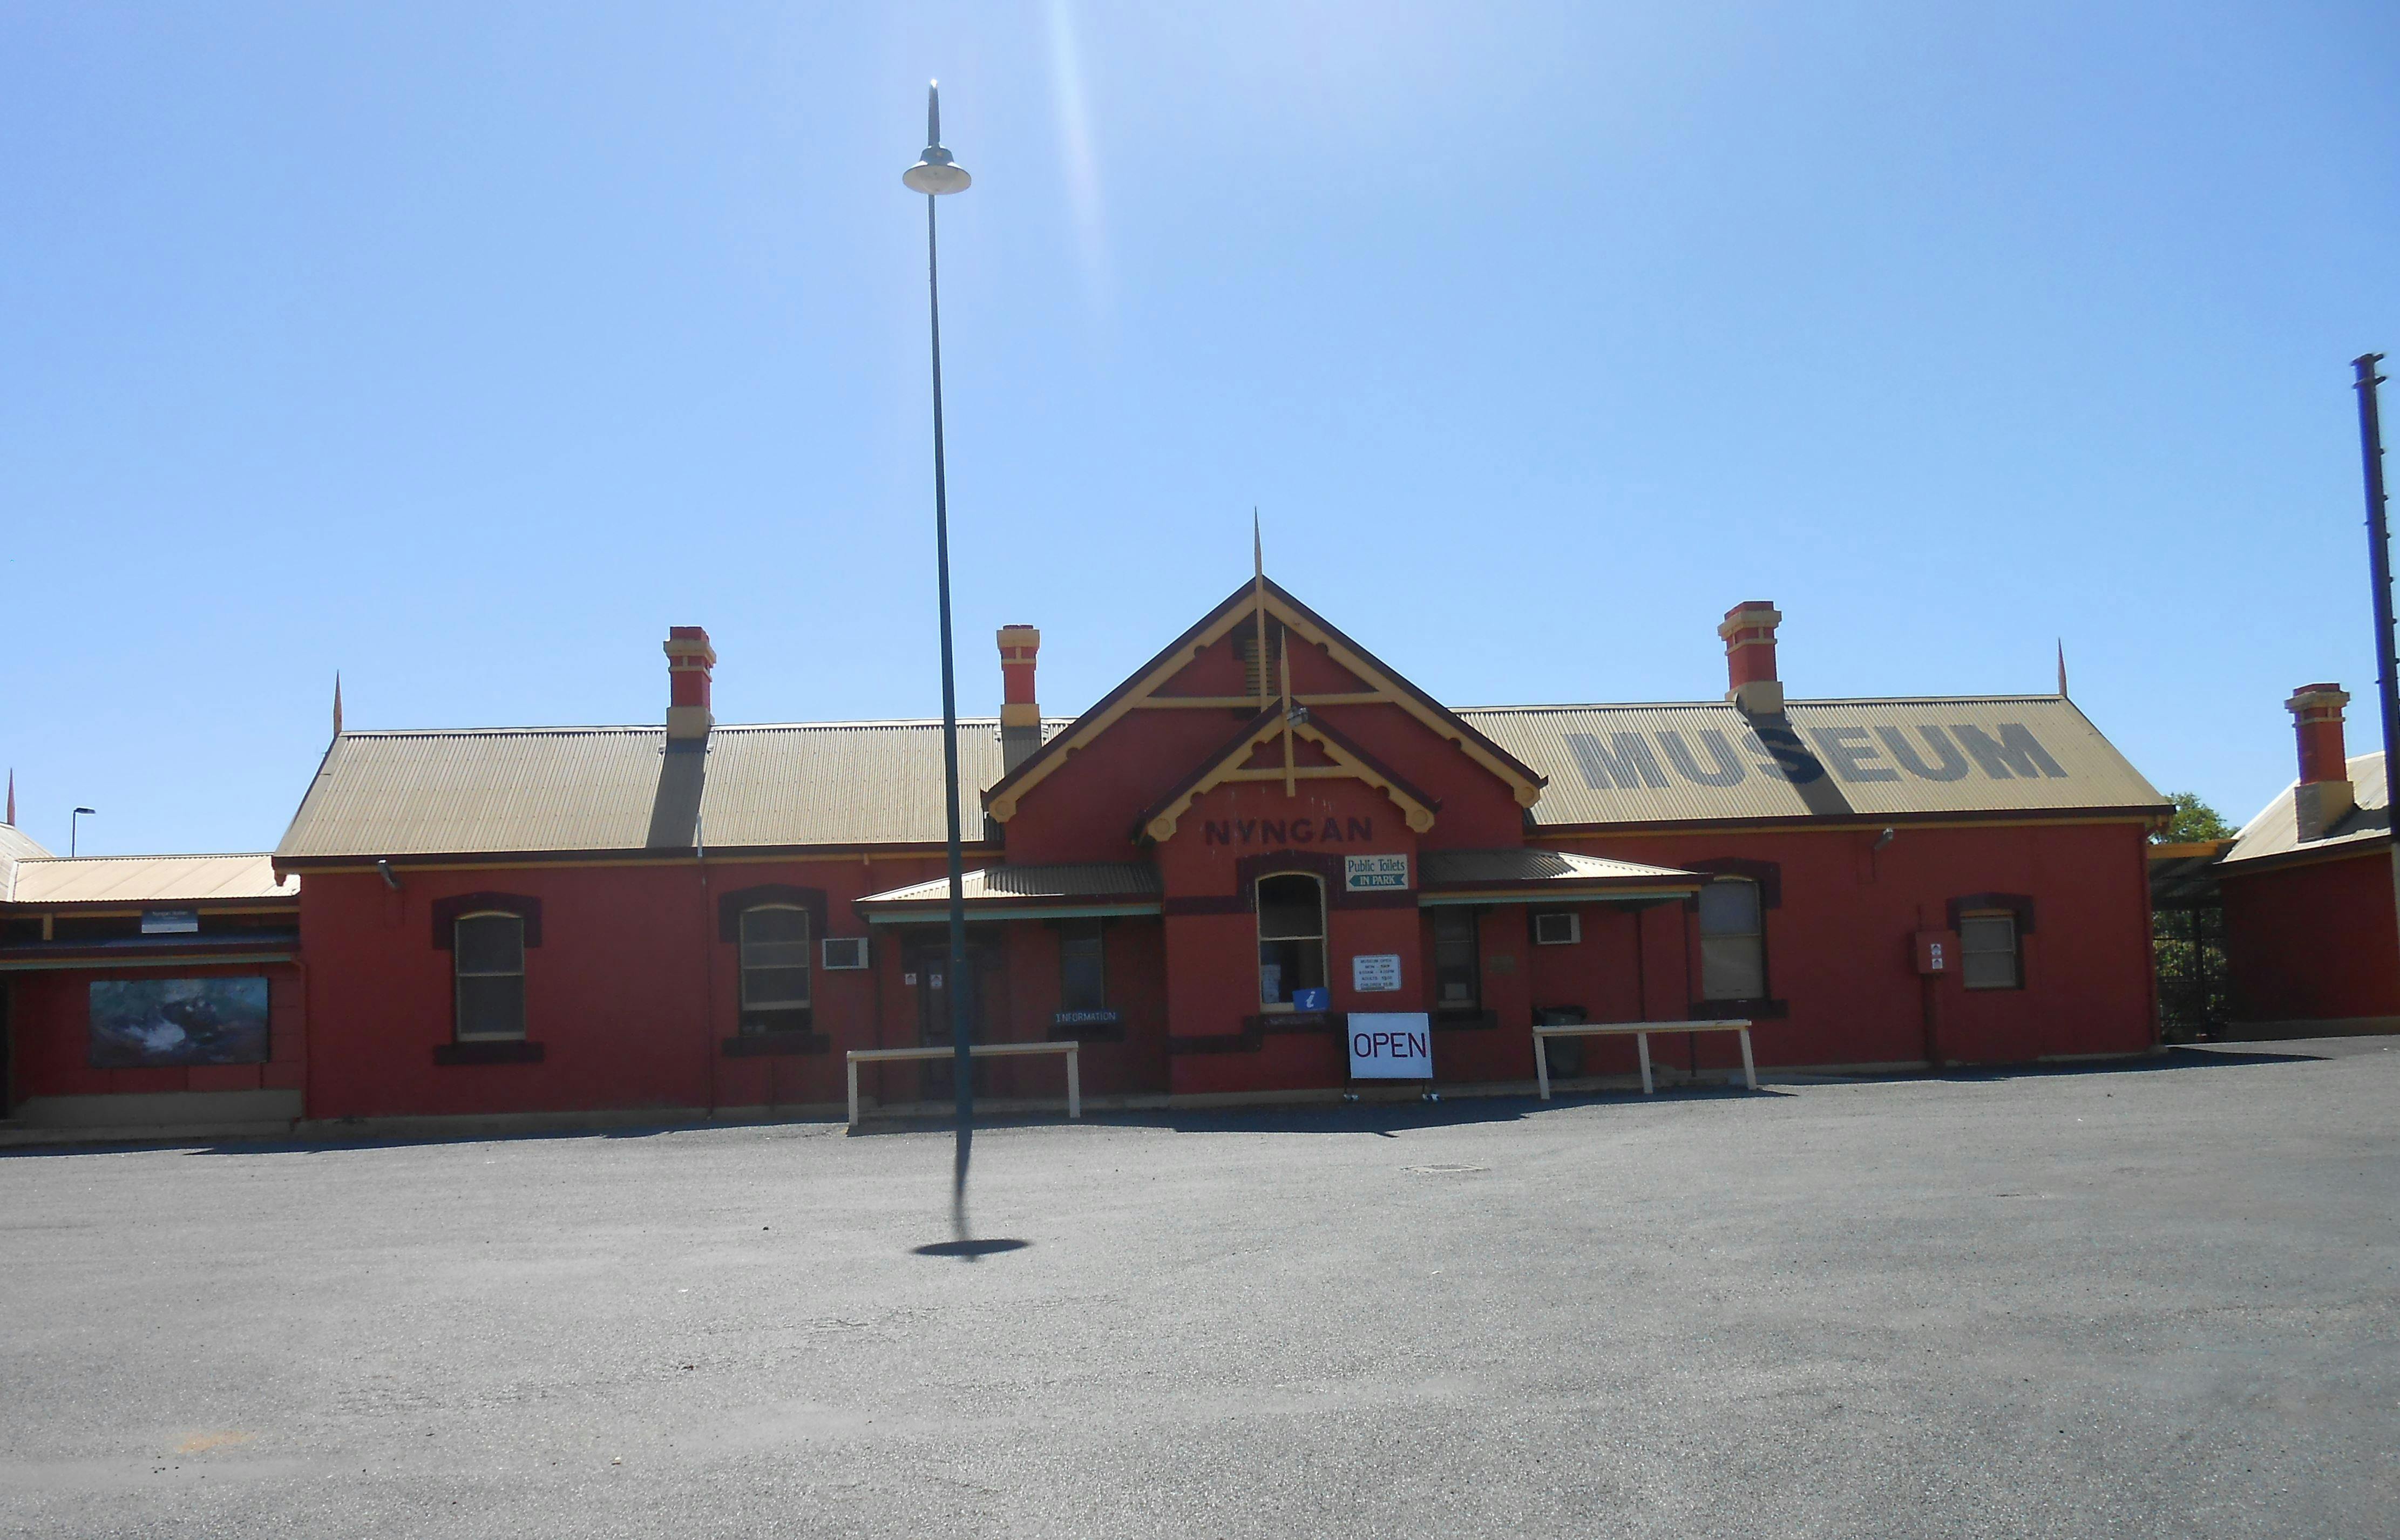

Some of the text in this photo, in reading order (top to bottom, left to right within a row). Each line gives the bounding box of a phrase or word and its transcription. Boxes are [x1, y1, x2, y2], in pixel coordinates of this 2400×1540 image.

[1561, 723, 2069, 790] MUSEUM
[1204, 816, 1373, 846] NYNGAN
[1348, 858, 1405, 872] Public Toilets
[1360, 875, 1395, 885] IN PARK
[1055, 1012, 1116, 1022] INFORMATION
[1354, 1032, 1426, 1058] OPEN
